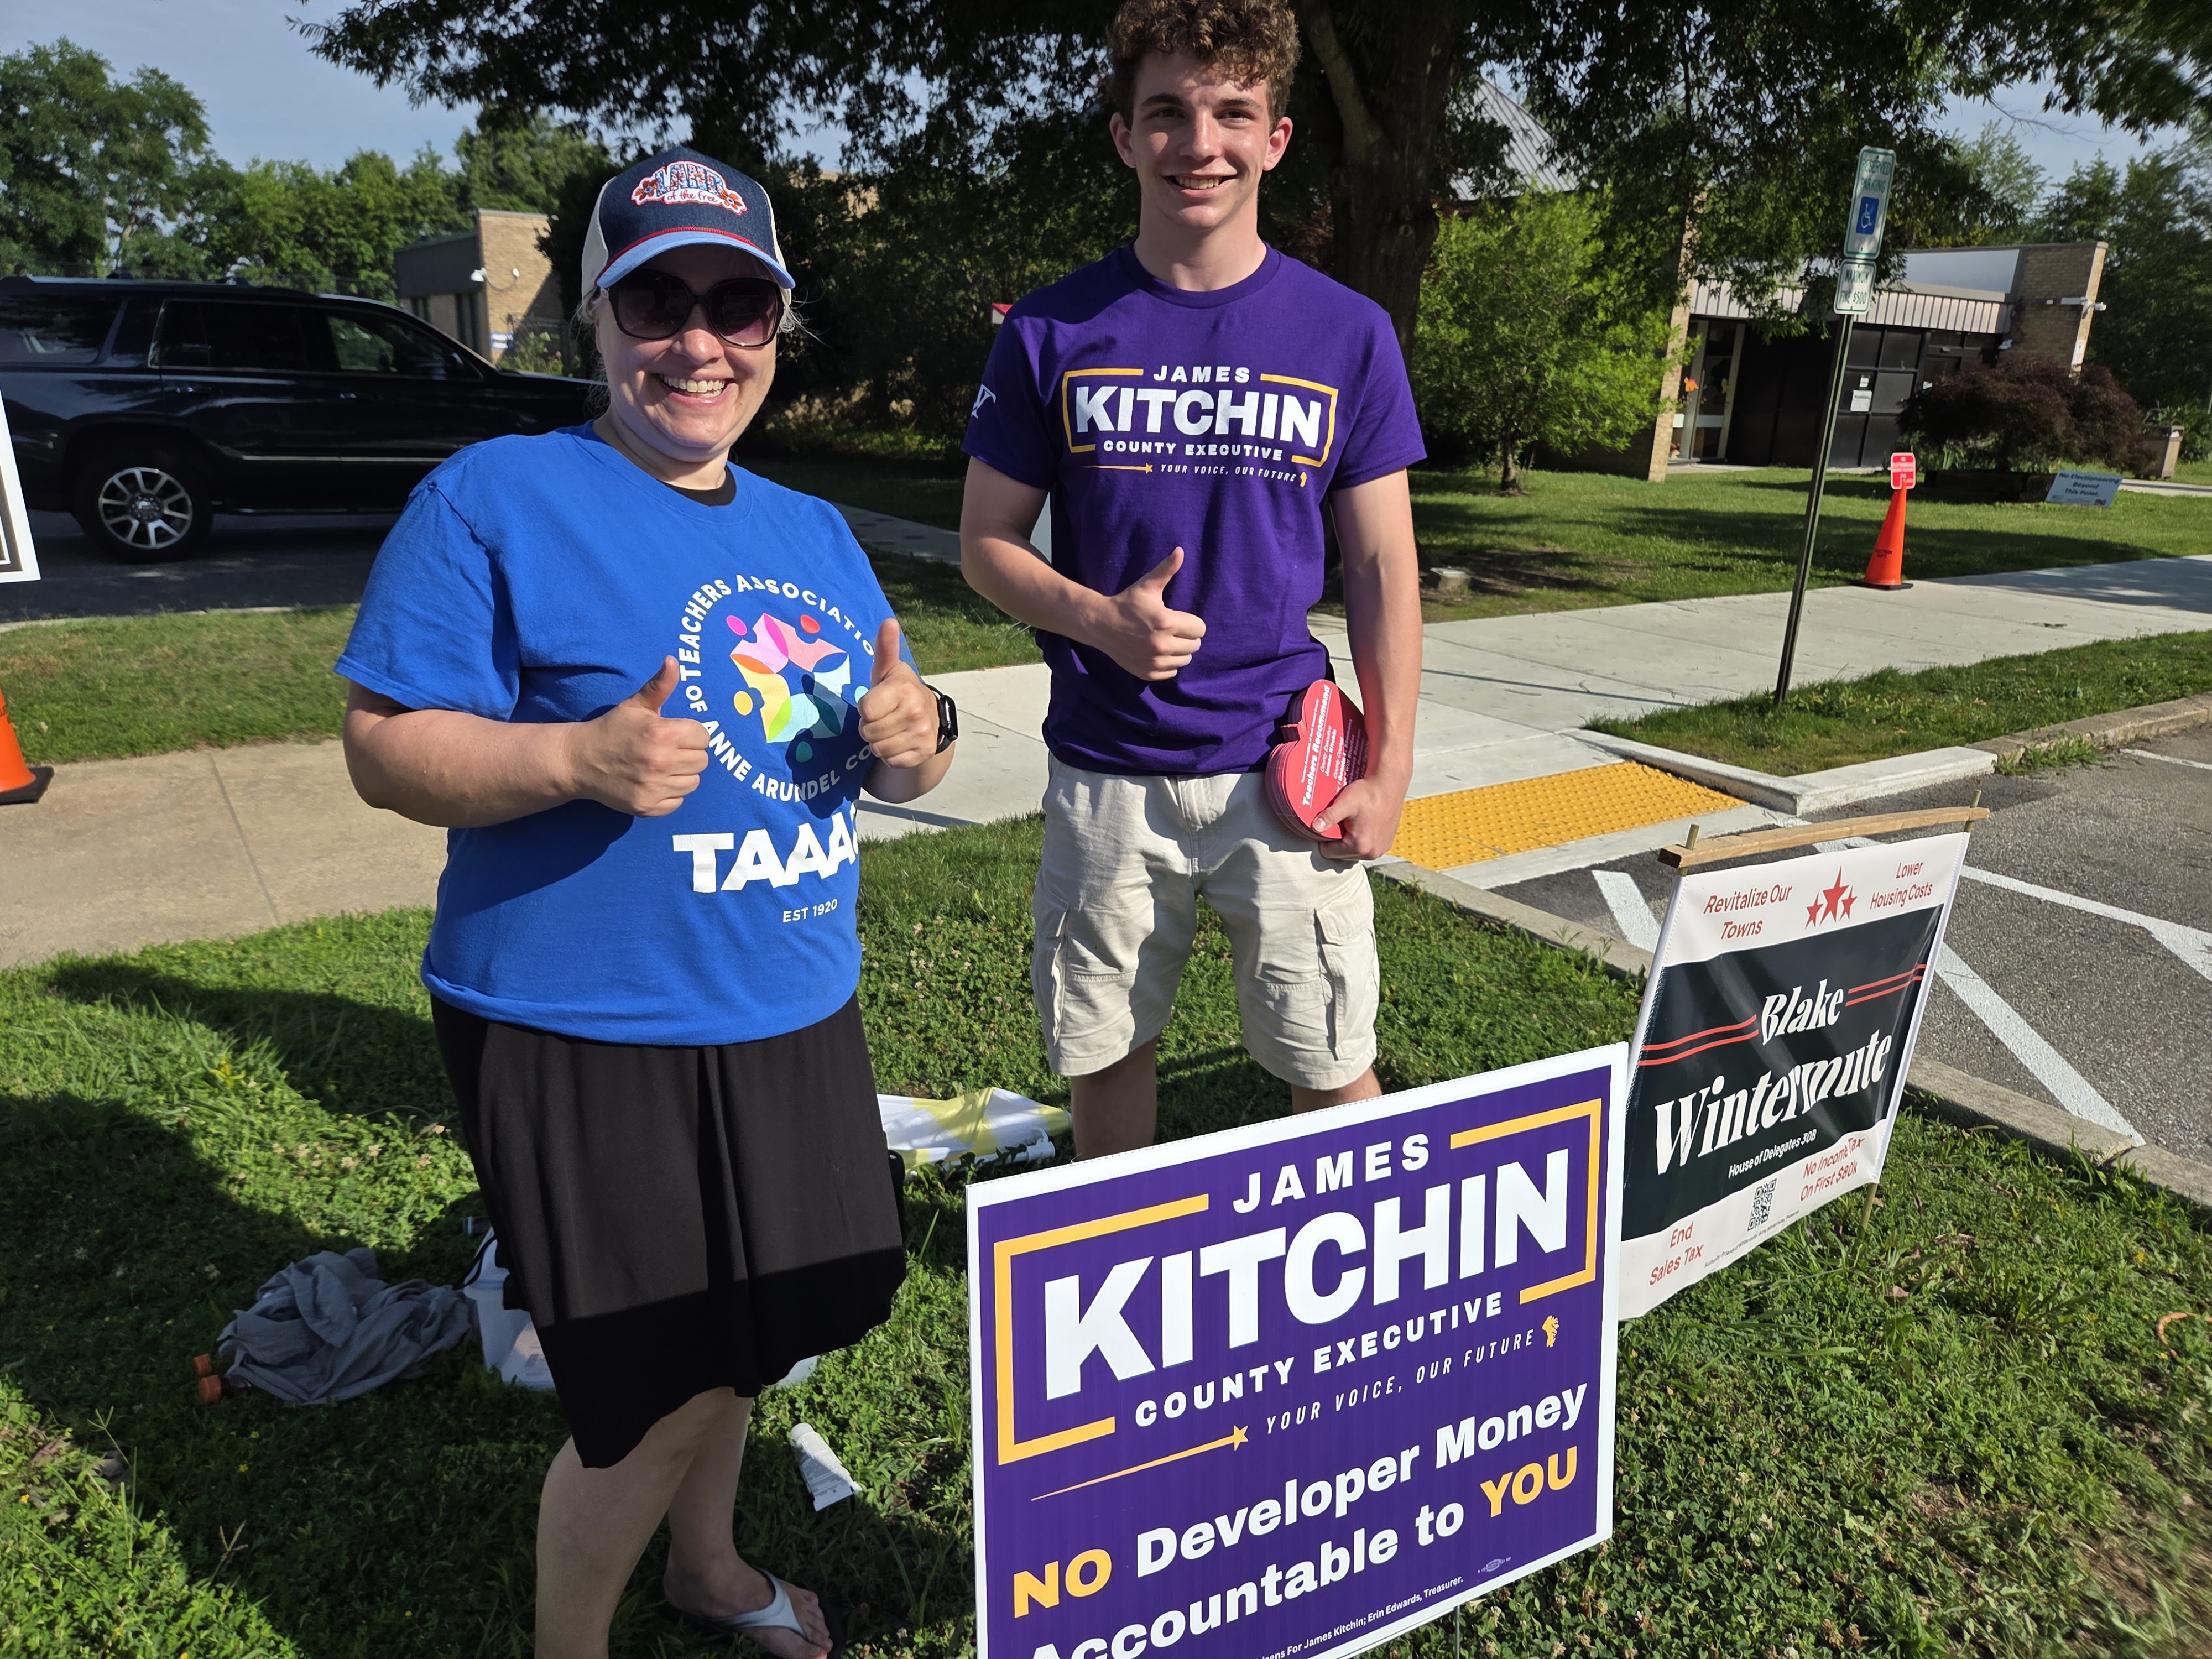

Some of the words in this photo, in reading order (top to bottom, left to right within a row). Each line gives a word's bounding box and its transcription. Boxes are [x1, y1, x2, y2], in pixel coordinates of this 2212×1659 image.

[655, 164, 723, 197] LAND
[1861, 158, 1891, 176] RESERVED
[1861, 177, 1886, 194] PARKING
[667, 191, 676, 201] of
[680, 189, 696, 199] the
[697, 191, 718, 203] free
[1844, 269, 1869, 284] MAXIMUM
[1839, 291, 1850, 304] FINE
[1853, 291, 1867, 305] $500
[1154, 365, 1250, 383] JAMES
[1076, 385, 1322, 448] KITCHIN
[1103, 440, 1177, 455] COUNTY
[1185, 442, 1283, 461] EXECUTIVE
[1161, 463, 1187, 473] YOUR
[1194, 465, 1228, 475] VOICE,
[1235, 467, 1254, 476] OUR
[1258, 468, 1296, 482] FUTURE
[678, 578, 732, 682] TEACHERS
[736, 574, 875, 662] ASSOCIATIO
[685, 685, 708, 712] OF
[701, 720, 752, 782] ANNE
[752, 773, 841, 803] ARUNDEL
[1302, 754, 1318, 806] Teachers
[1312, 684, 1330, 753] Recommend
[1329, 728, 1337, 753] Kitchin
[672, 801, 859, 893] TAAA
[1895, 860, 1923, 879] Lower
[782, 907, 809, 923] EST
[813, 899, 838, 917] 1920
[1703, 887, 1768, 914] Revitalize
[1770, 884, 1793, 903] Our
[1870, 889, 1908, 911] Housing
[1908, 882, 1933, 902] Costs
[1721, 918, 1764, 940] Towns
[1761, 978, 1844, 1046] Blake
[1655, 1029, 1893, 1176] Wintermute
[1728, 1157, 1754, 1179] House
[1755, 1154, 1764, 1167] of
[1763, 1138, 1800, 1160] Delegates
[1801, 1129, 1817, 1146] 30B
[1803, 1161, 1816, 1179] No
[1817, 1144, 1849, 1171] Income
[1848, 1137, 1865, 1156] Tax
[1233, 1133, 1430, 1214] JAMES
[1801, 1184, 1813, 1202] On
[1815, 1173, 1835, 1192] First
[1670, 1221, 1694, 1249] End
[1045, 1148, 1568, 1401] KITCHIN
[1649, 1260, 1681, 1287] Sales
[1683, 1244, 1704, 1266] Tax
[1135, 1357, 1295, 1427] COUNTY
[1313, 1291, 1501, 1375] EXECUTIVE
[1266, 1401, 1320, 1436] YOUR
[1335, 1375, 1403, 1413] VOICE,
[1416, 1357, 1453, 1383] OUR
[1464, 1328, 1534, 1369] FUTURE
[1013, 1548, 1112, 1619] NO
[1137, 1444, 1420, 1579] Developer
[1435, 1383, 1588, 1469] Money
[1416, 1498, 1464, 1549] to
[1480, 1446, 1578, 1516] YOU
[1287, 1643, 1302, 1656] For
[1304, 1631, 1332, 1649] James
[1334, 1617, 1366, 1636] Kitchin;
[1368, 1609, 1384, 1623] Erin
[1386, 1594, 1422, 1615] Edwards,
[1423, 1576, 1464, 1598] Treasurer.
